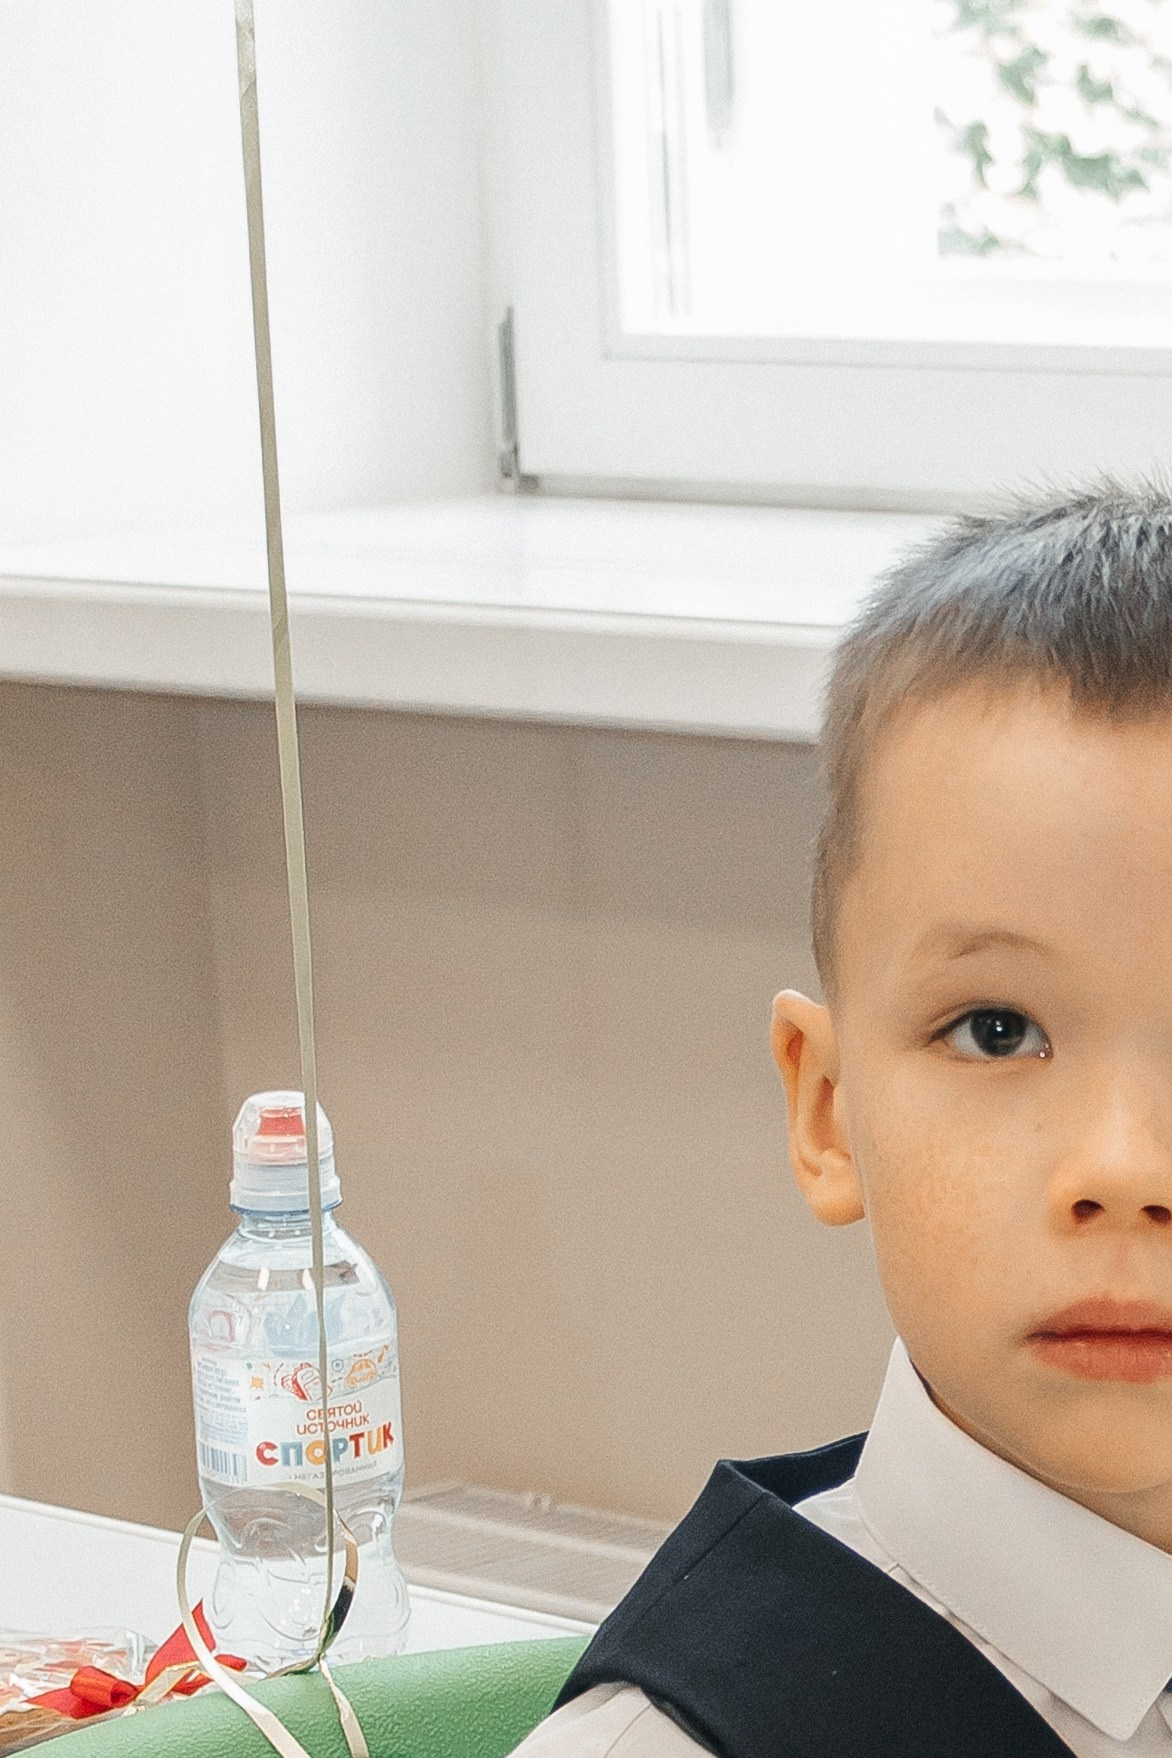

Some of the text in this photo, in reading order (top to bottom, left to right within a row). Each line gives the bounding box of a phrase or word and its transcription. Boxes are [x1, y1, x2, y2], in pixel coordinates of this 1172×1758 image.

[306, 1400, 362, 1421] СВЯТОЙ
[296, 1413, 370, 1435] ИСТОЧНИК
[256, 1421, 394, 1467] СПОРТИК
